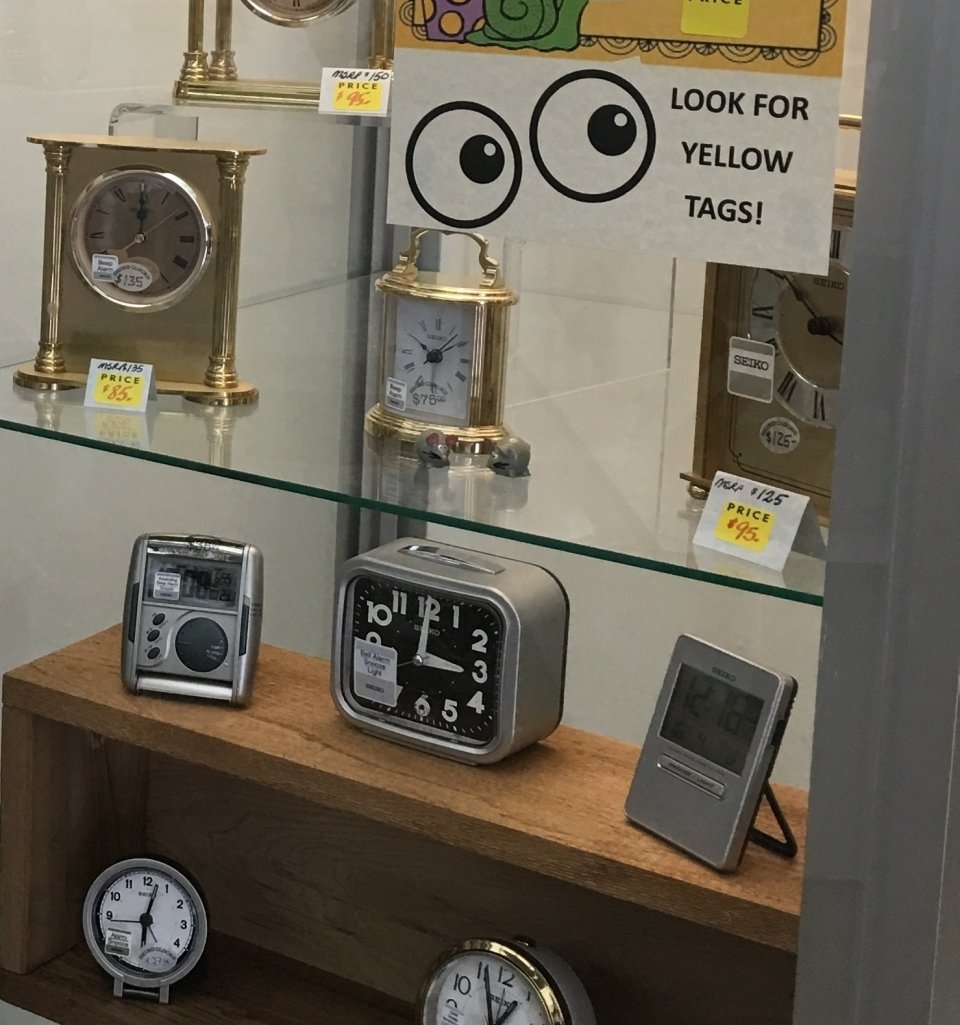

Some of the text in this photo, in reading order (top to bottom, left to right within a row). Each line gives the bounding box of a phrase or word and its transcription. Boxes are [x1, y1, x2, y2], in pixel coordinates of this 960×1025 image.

[338, 82, 377, 90] PRICE
[671, 87, 809, 120] LOOK FOR
[681, 141, 793, 174] YELLOW
[685, 195, 763, 225] TAGS!
[114, 274, 144, 287] $135
[814, 278, 844, 289] SEIKO
[733, 354, 770, 371] SEIKO
[101, 373, 140, 384] PRICE
[751, 487, 789, 506] $125
[727, 502, 770, 523] PRICE
[392, 590, 407, 615] 11
[366, 600, 392, 626] 10
[453, 605, 460, 628] 1
[471, 629, 488, 653] 2
[471, 660, 488, 684] 3
[414, 694, 431, 717] 6
[442, 699, 458, 723] 5
[466, 690, 485, 714] 4
[125, 879, 133, 889] 11
[142, 876, 153, 886] 12
[165, 884, 169, 894] 1
[110, 892, 121, 901] 10
[176, 899, 184, 909] 2
[106, 911, 113, 920] 9
[180, 920, 187, 929] 3
[174, 938, 180, 948] 4
[454, 973, 471, 995] 10
